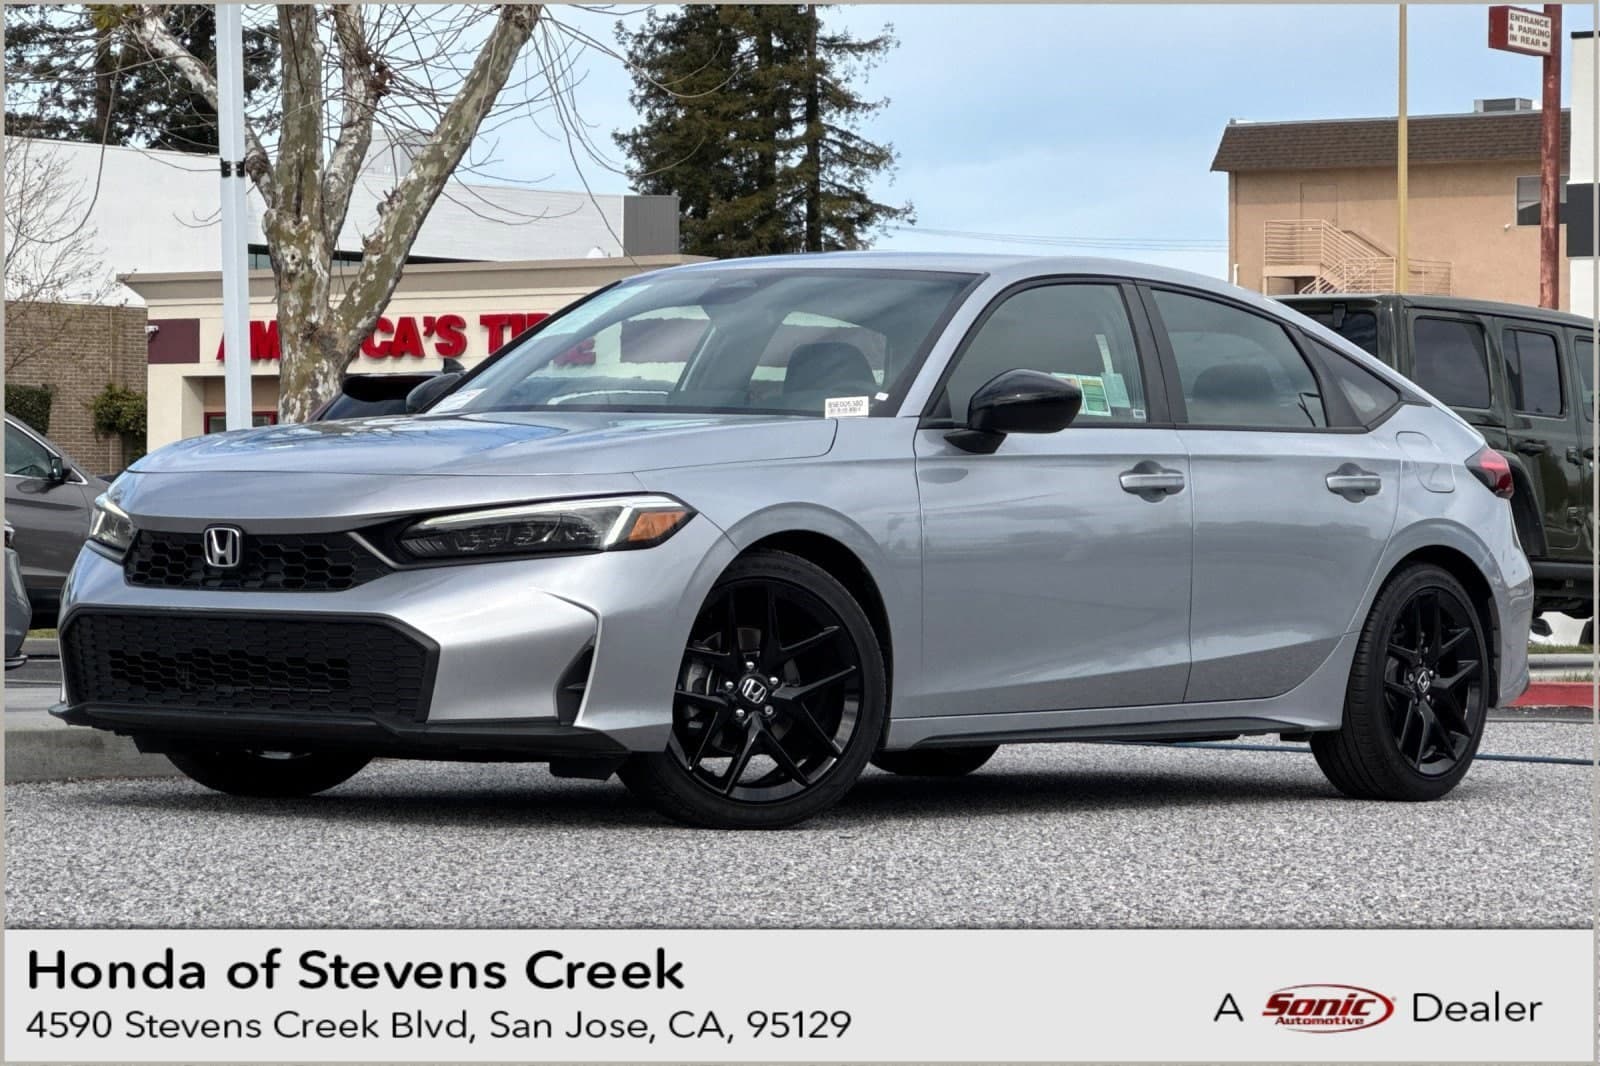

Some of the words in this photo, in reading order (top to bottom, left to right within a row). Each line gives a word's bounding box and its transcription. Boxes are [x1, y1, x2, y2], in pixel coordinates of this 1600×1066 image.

[1510, 13, 1549, 28] ENTRANCE
[1518, 25, 1550, 38] PARKING
[1510, 34, 1517, 42] IN
[1520, 36, 1541, 46] REAR
[216, 313, 468, 361] MCA'S
